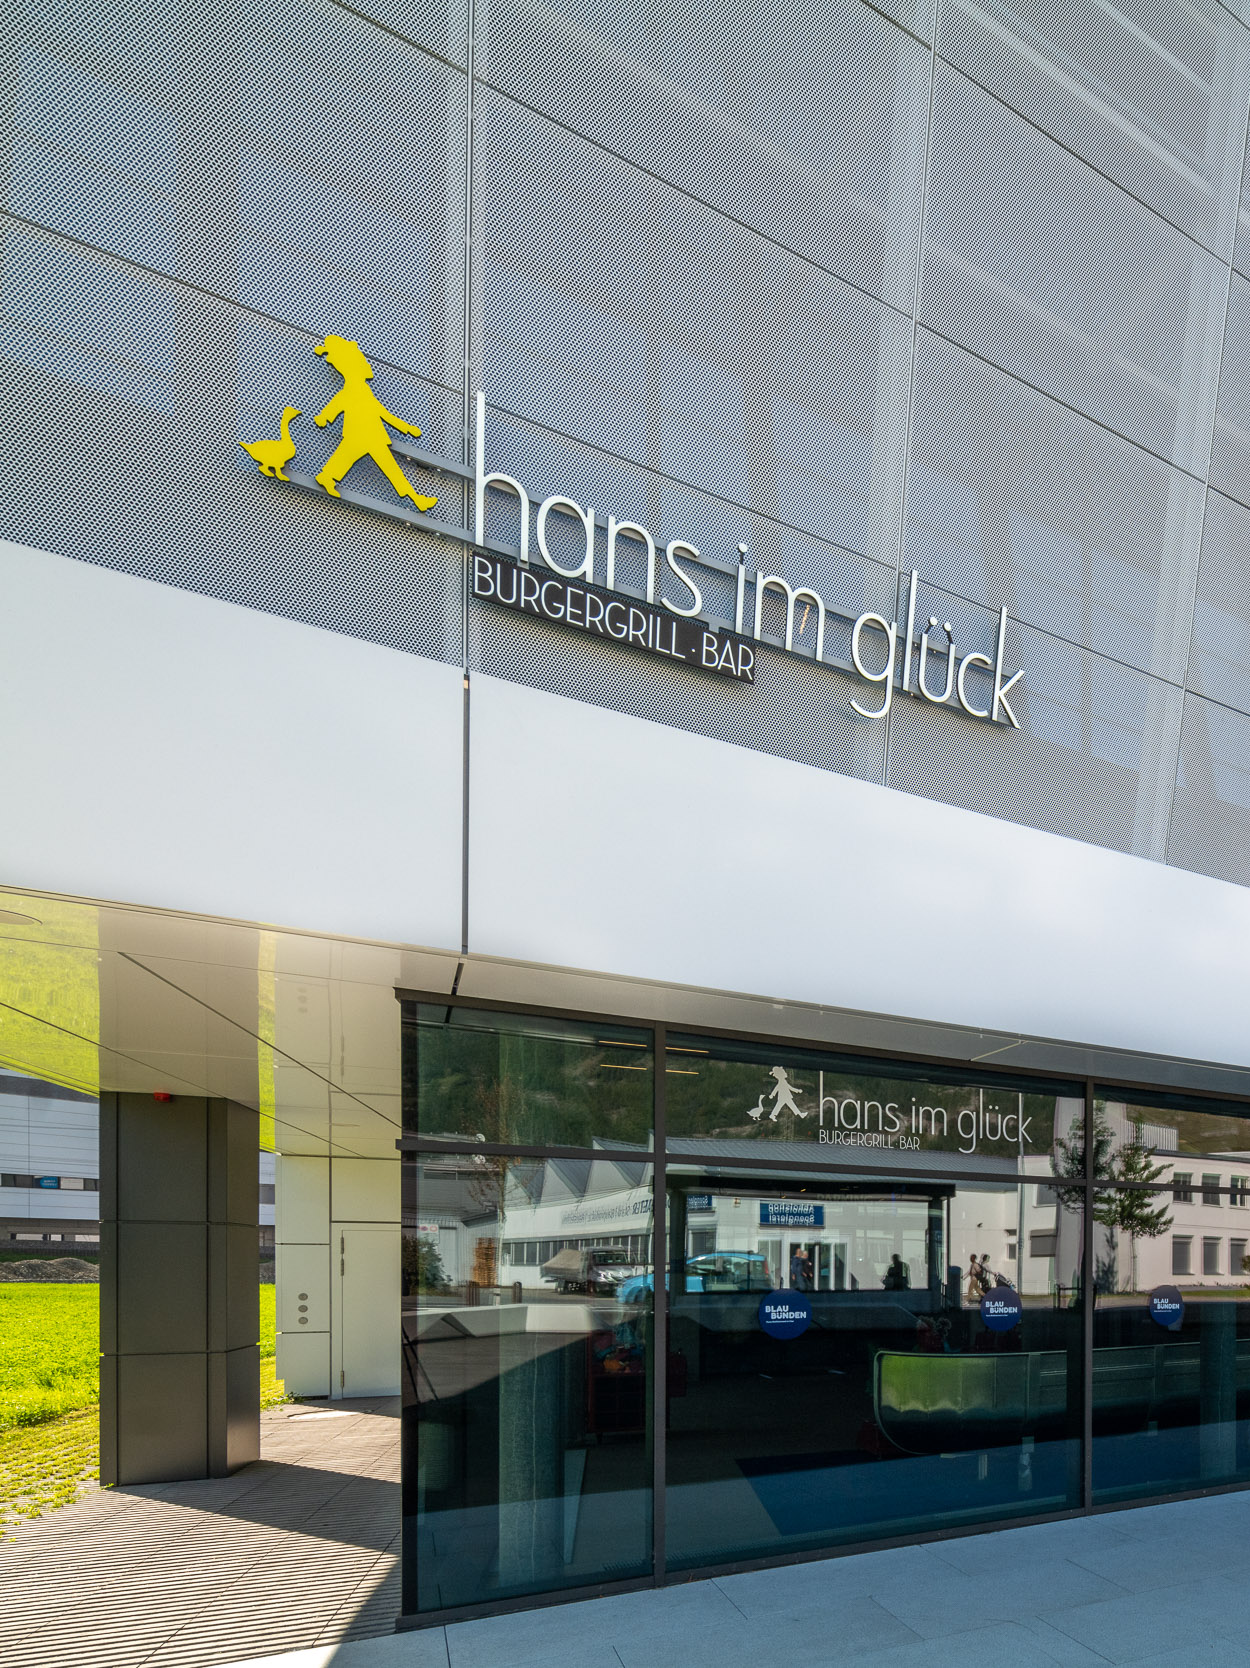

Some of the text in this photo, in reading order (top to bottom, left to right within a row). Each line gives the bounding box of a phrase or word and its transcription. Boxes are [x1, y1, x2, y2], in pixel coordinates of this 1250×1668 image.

[474, 391, 1025, 729] hans im glück
[473, 554, 755, 682] BURGERGRILL BAR
[819, 1070, 1033, 1154] hans im glück
[819, 1129, 920, 1151] BURGERGRILL BAR
[765, 1305, 789, 1313] BLAU
